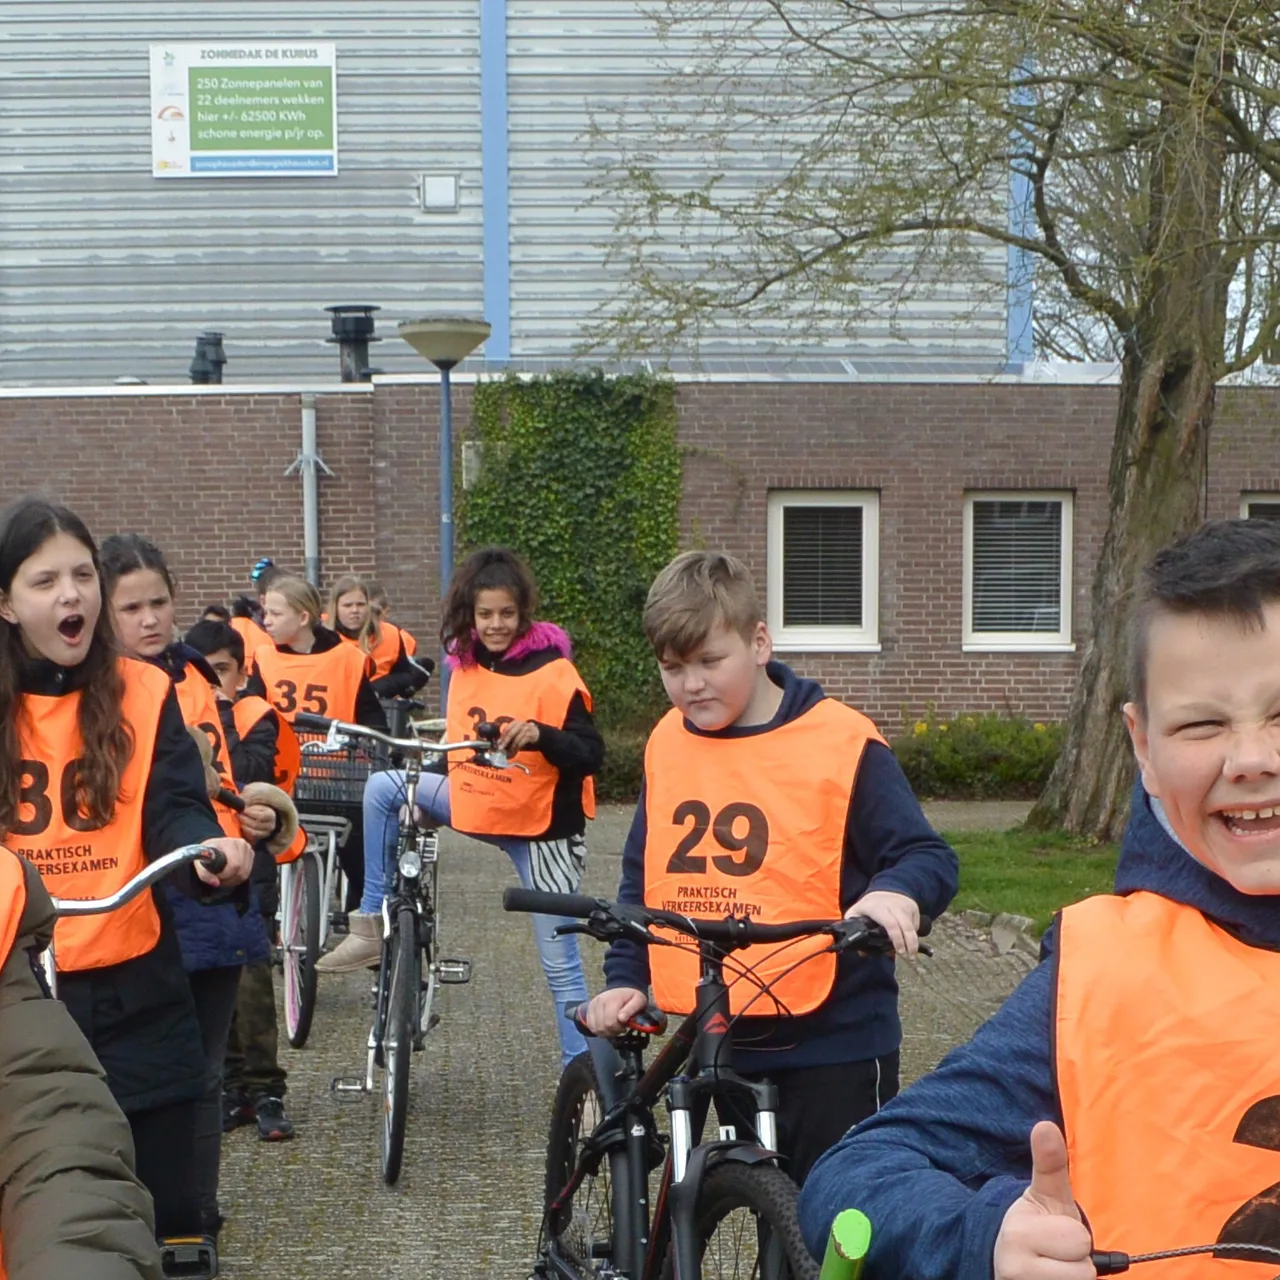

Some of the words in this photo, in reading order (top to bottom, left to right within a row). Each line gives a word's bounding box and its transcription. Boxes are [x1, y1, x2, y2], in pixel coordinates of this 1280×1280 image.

[265, 49, 278, 59] DE
[282, 48, 319, 59] KUBUS
[197, 77, 219, 89] 250
[220, 77, 301, 91] Zonnepanelen
[302, 79, 324, 89] van
[197, 94, 212, 106] 22
[214, 93, 280, 105] deelnemers
[281, 93, 325, 105] wekken
[197, 111, 219, 122] hier
[222, 112, 239, 122] +/-
[240, 111, 277, 122] 62500
[279, 110, 307, 122] KWh
[197, 128, 238, 140] schone
[239, 128, 282, 141] energie
[284, 126, 305, 141] p/jr
[306, 129, 325, 140] op.
[272, 679, 328, 716] 35
[666, 799, 770, 878] 29
[34, 857, 119, 876] ERSEXAMEN
[677, 885, 738, 900] PRAKTISCH
[661, 899, 763, 917] VERKEERSEXAMEN
